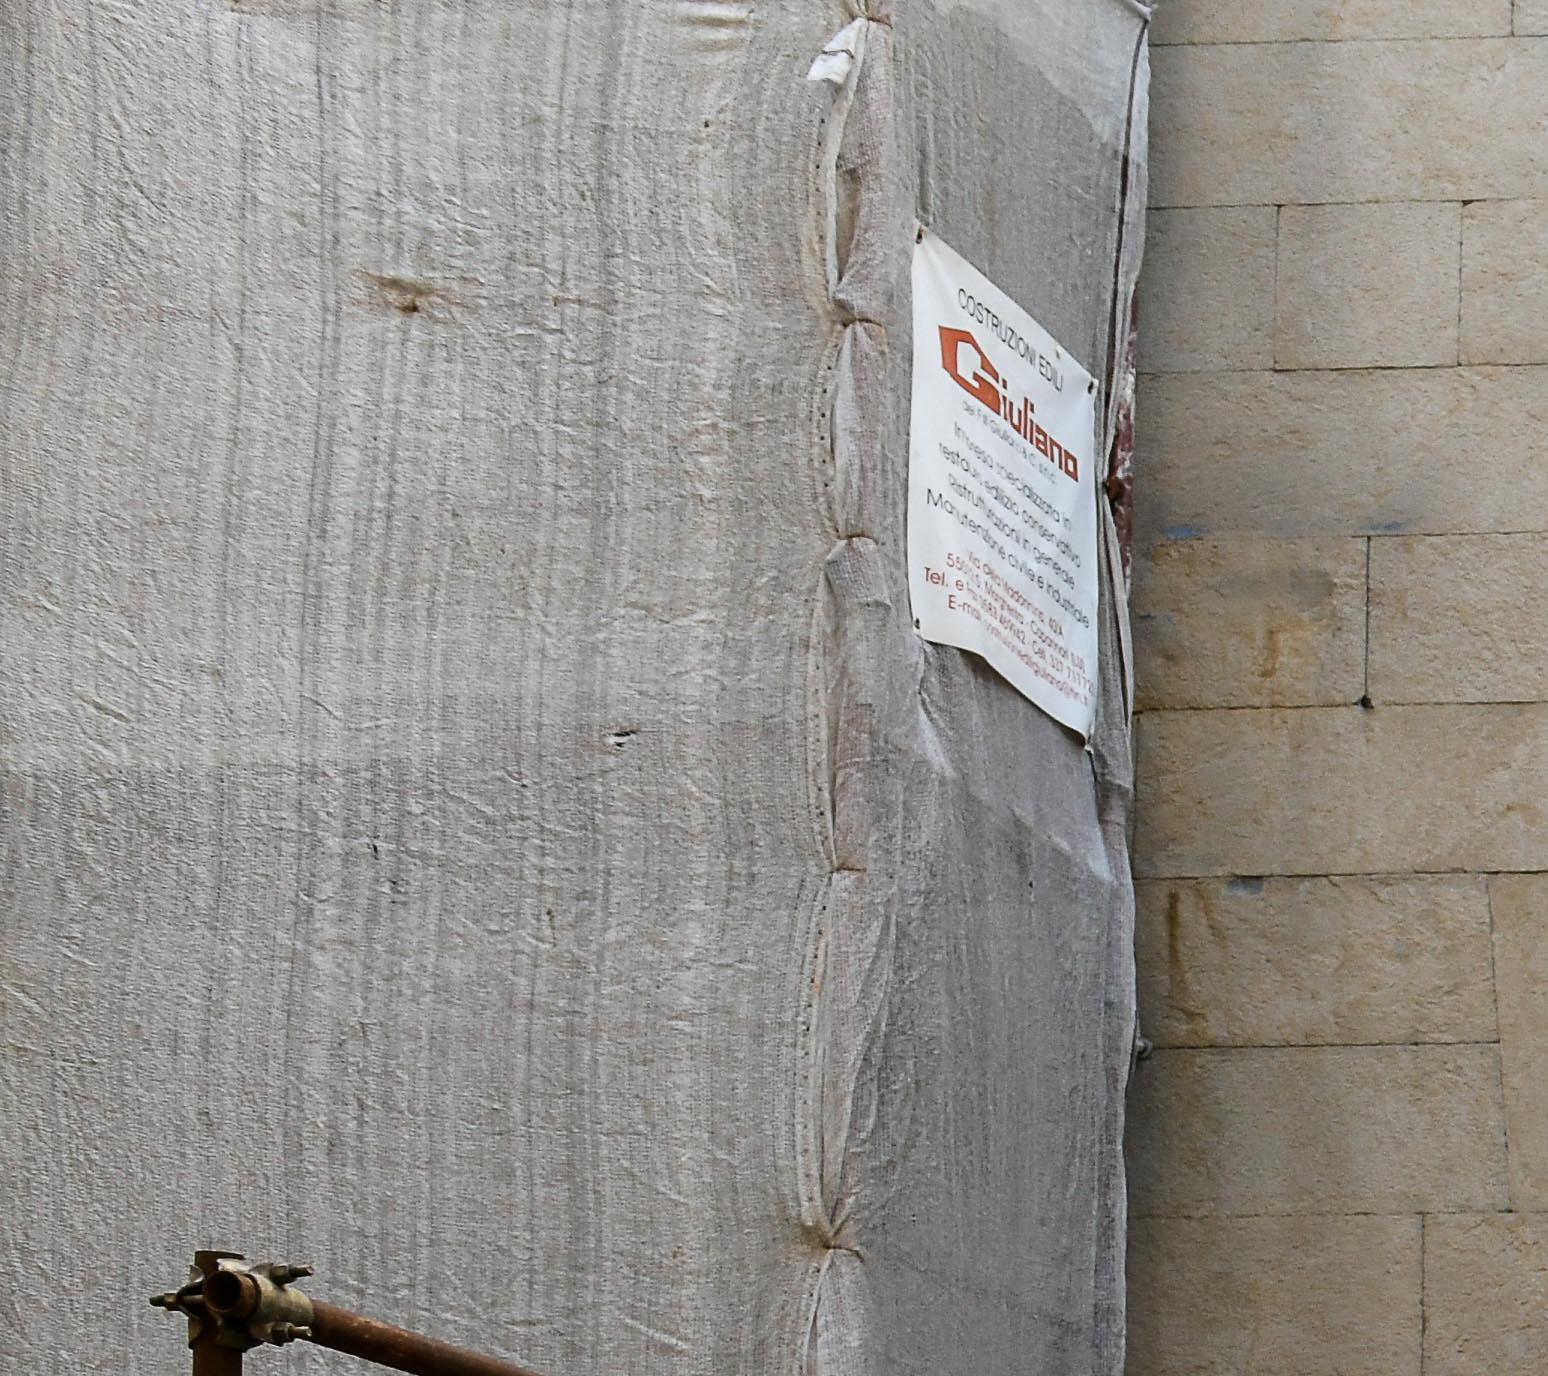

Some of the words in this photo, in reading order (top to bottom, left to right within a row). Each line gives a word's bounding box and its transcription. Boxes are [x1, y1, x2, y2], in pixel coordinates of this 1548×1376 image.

[937, 325, 1079, 482] Giuliano
[958, 288, 1035, 367] COSTRUZIONI
[1039, 354, 1064, 392] EDILI
